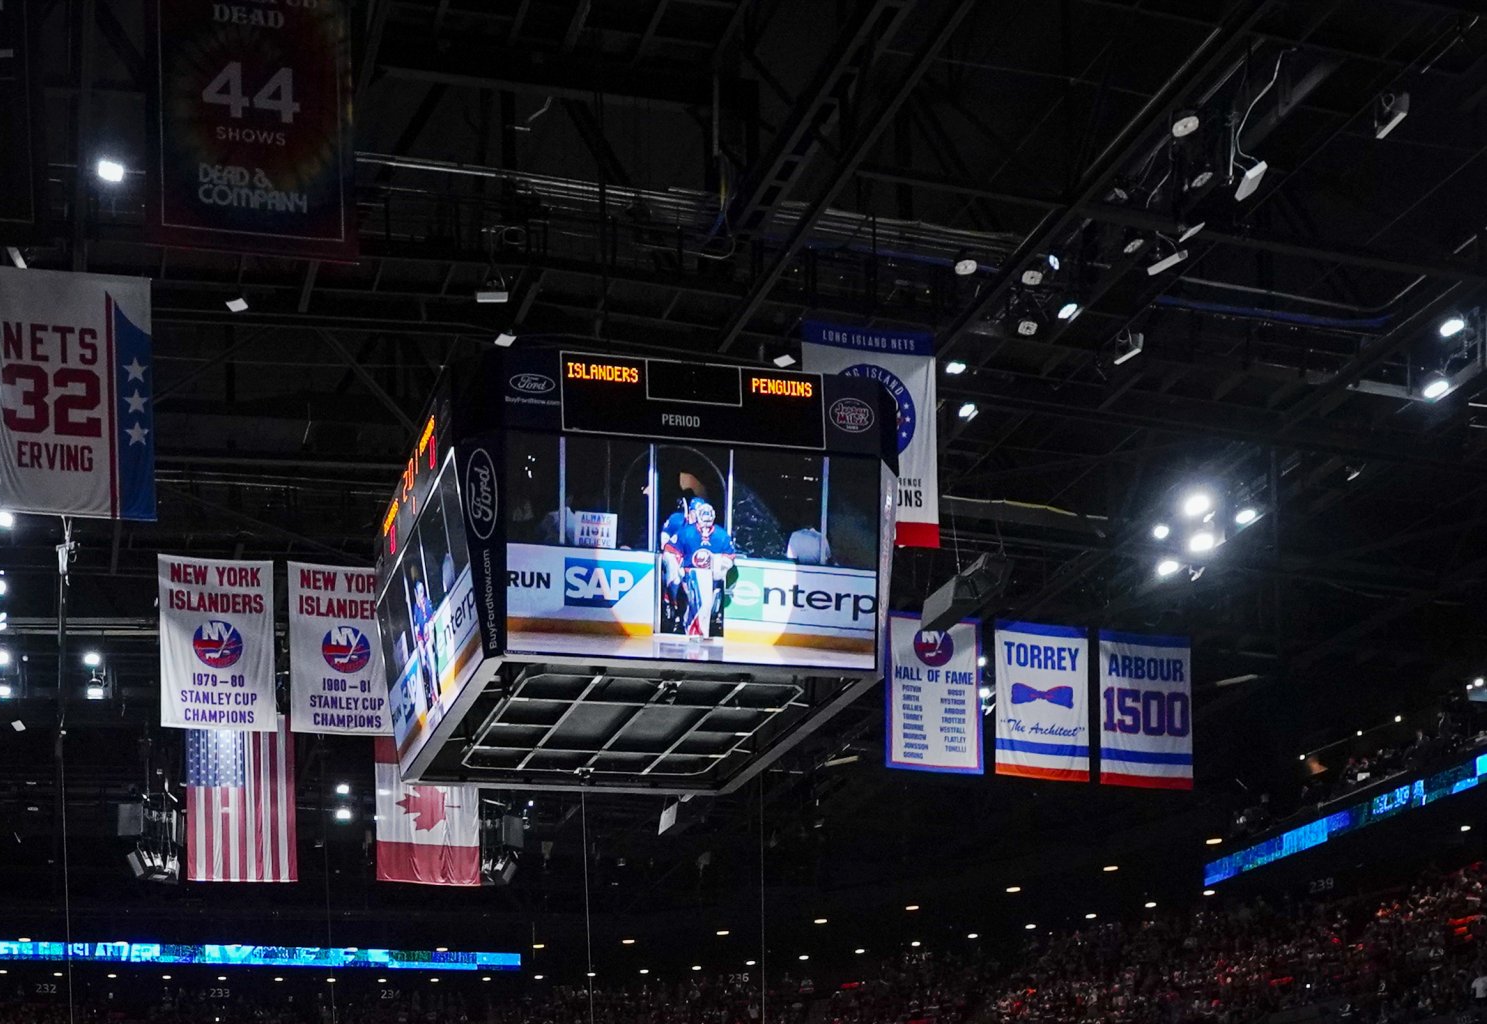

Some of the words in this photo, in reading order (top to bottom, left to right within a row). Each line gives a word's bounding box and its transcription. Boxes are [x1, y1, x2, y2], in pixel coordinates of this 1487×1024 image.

[211, 5, 285, 30] DEAD
[200, 61, 301, 124] 44
[215, 126, 287, 147] SHOWS
[3, 321, 98, 366] NETS
[822, 329, 847, 343] LONG
[852, 332, 887, 348] ISLAND
[891, 338, 916, 351] NETS
[517, 375, 548, 391] Ford
[568, 362, 639, 383] ISLANDERS
[867, 365, 903, 396] ISLAND
[751, 378, 813, 398] PENGUINS
[2, 363, 102, 438] 32
[662, 413, 701, 428] PERIOD
[17, 440, 93, 472] ERVING
[470, 465, 493, 522] Ford
[170, 562, 208, 586] NEW
[216, 567, 261, 588] YORK
[300, 569, 337, 592] NEW
[506, 570, 551, 589] RUN
[566, 564, 634, 601] SAP
[169, 589, 264, 614] ISLANDERS
[475, 548, 499, 651] BuyFordNow.com
[1003, 640, 1079, 672] TORREY
[1108, 653, 1184, 682] ARBOUR
[895, 665, 923, 681] HALL
[927, 669, 941, 683] OF
[946, 671, 974, 686] FAME
[181, 690, 233, 706] STANLEY
[234, 692, 258, 706] CUP
[310, 695, 362, 711] STANLEY
[362, 697, 385, 711] CUP
[184, 709, 255, 724] CHAMPIONS
[313, 713, 382, 729] CHAMPIONS
[1103, 686, 1190, 738] 1500
[35, 983, 57, 994] 232
[728, 972, 750, 983] 236
[209, 988, 231, 998] 233
